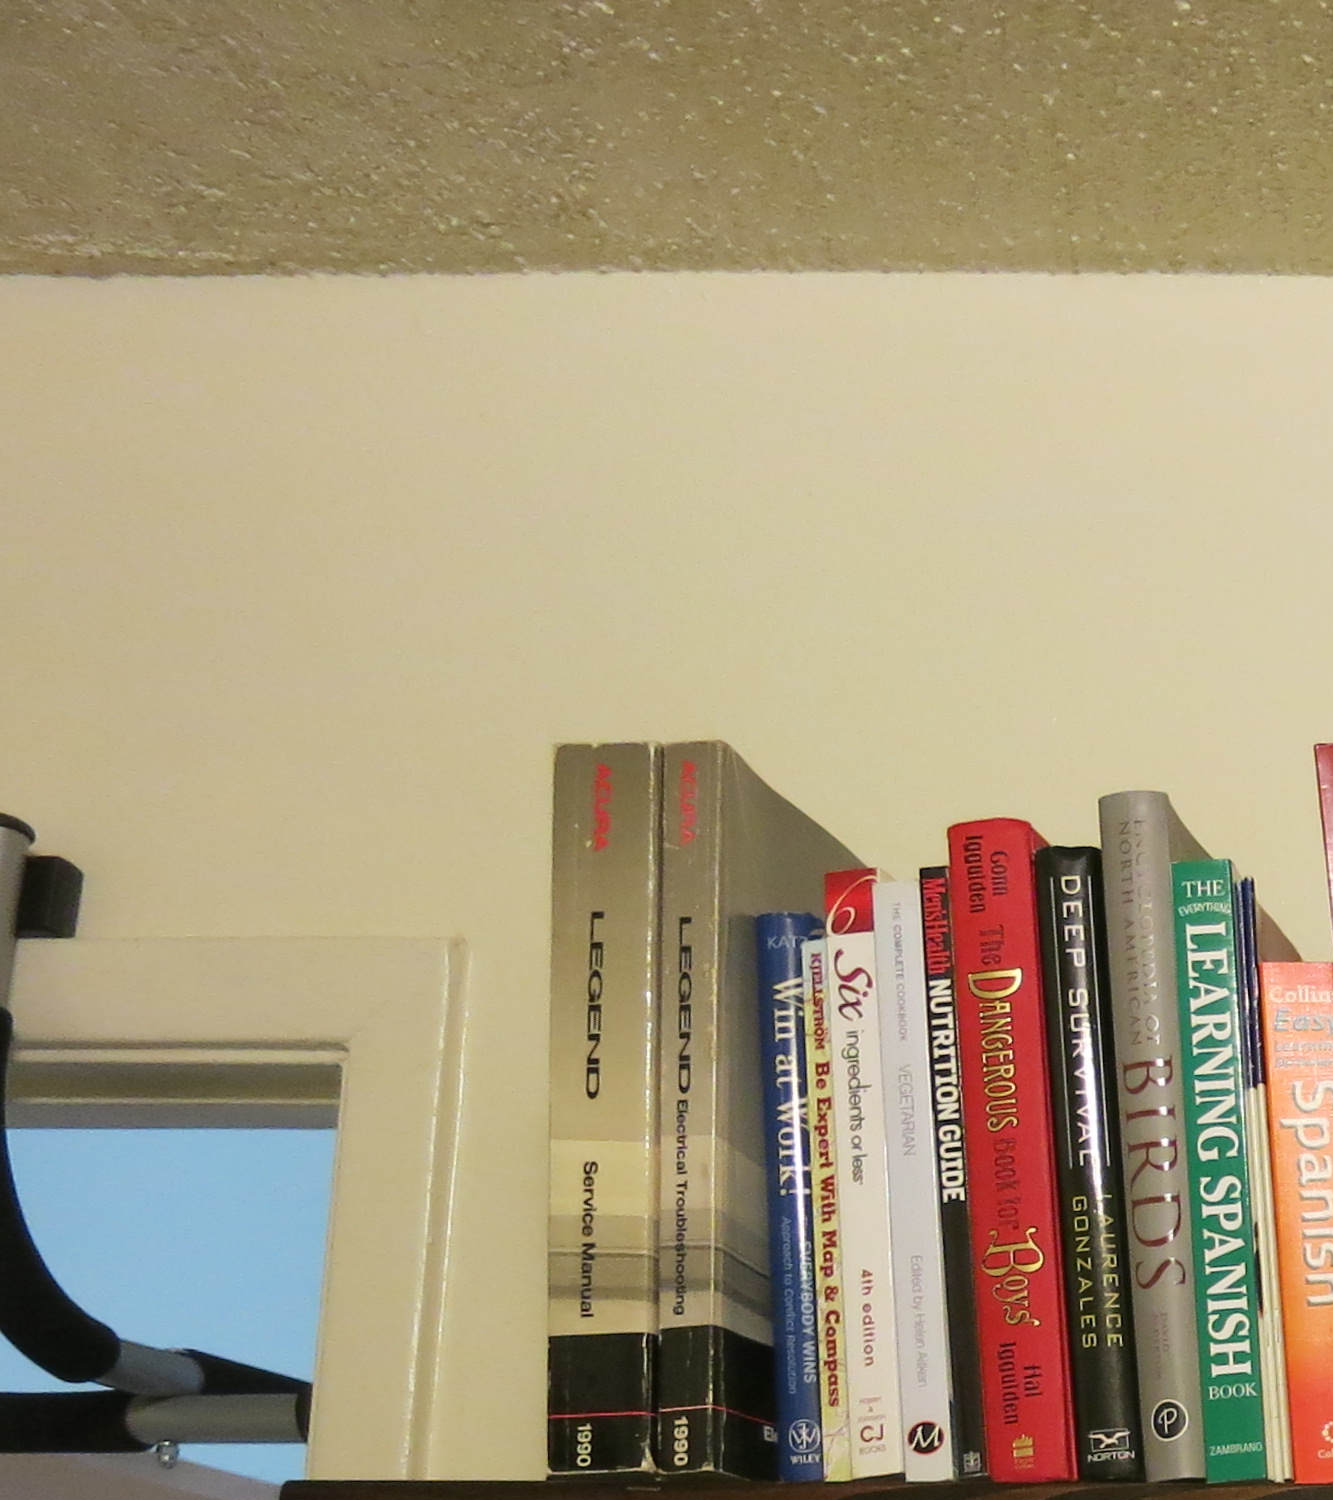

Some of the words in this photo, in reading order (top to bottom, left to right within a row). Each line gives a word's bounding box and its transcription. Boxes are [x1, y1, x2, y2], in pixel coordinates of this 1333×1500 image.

[965, 834, 987, 913] Iggulden
[990, 850, 1008, 896] Conn
[1119, 820, 1134, 905] NORTH
[1180, 879, 1225, 898] THE
[1061, 875, 1086, 968] DEEP
[586, 911, 604, 1100] LEGEND
[678, 917, 692, 1094] LEGEND
[773, 976, 804, 1042] Win
[834, 947, 873, 1022] Six
[1122, 916, 1143, 1046] AMERICAN
[929, 979, 962, 1122] NUTRITION
[968, 968, 1024, 1133] DANGEROUS
[1145, 1015, 1160, 1045] OF
[1184, 922, 1240, 1163] LEARNING
[775, 1053, 803, 1089] at
[814, 1062, 831, 1090] Be
[841, 1030, 871, 1132] ingredients
[1067, 988, 1094, 1167] SURVIVAL
[673, 1099, 689, 1176] Electrical
[776, 1095, 811, 1197] Work!
[811, 1097, 834, 1170] Expert
[899, 1065, 917, 1158] VEGETARIAN
[581, 1161, 598, 1237] Service
[819, 1175, 836, 1224] With
[936, 1124, 966, 1203] GUIDE
[1123, 1054, 1187, 1291] BIRDS
[580, 1242, 596, 1318] Manual
[672, 1179, 688, 1316] Troubleshooting
[781, 1216, 793, 1270] Approach
[821, 1229, 839, 1279] Map
[1072, 1196, 1097, 1348] GONZALES
[1201, 1175, 1252, 1378] SPANISH
[784, 1288, 797, 1332] Conflict
[824, 1286, 840, 1302] &
[861, 1268, 874, 1296] 4th
[787, 1335, 798, 1395] Resolution
[803, 1340, 817, 1385] WINS
[823, 1310, 840, 1408] Compass
[861, 1303, 877, 1367] edition
[1000, 1341, 1018, 1425] Iggulden
[1023, 1364, 1042, 1397] Hal
[1208, 1382, 1258, 1400] BOOK
[577, 1423, 592, 1467] 1990
[673, 1415, 689, 1467] 1990
[790, 1454, 821, 1465] WILEY
[1088, 1450, 1135, 1464] NORTON
[1210, 1443, 1263, 1456] ZAMBRANO
